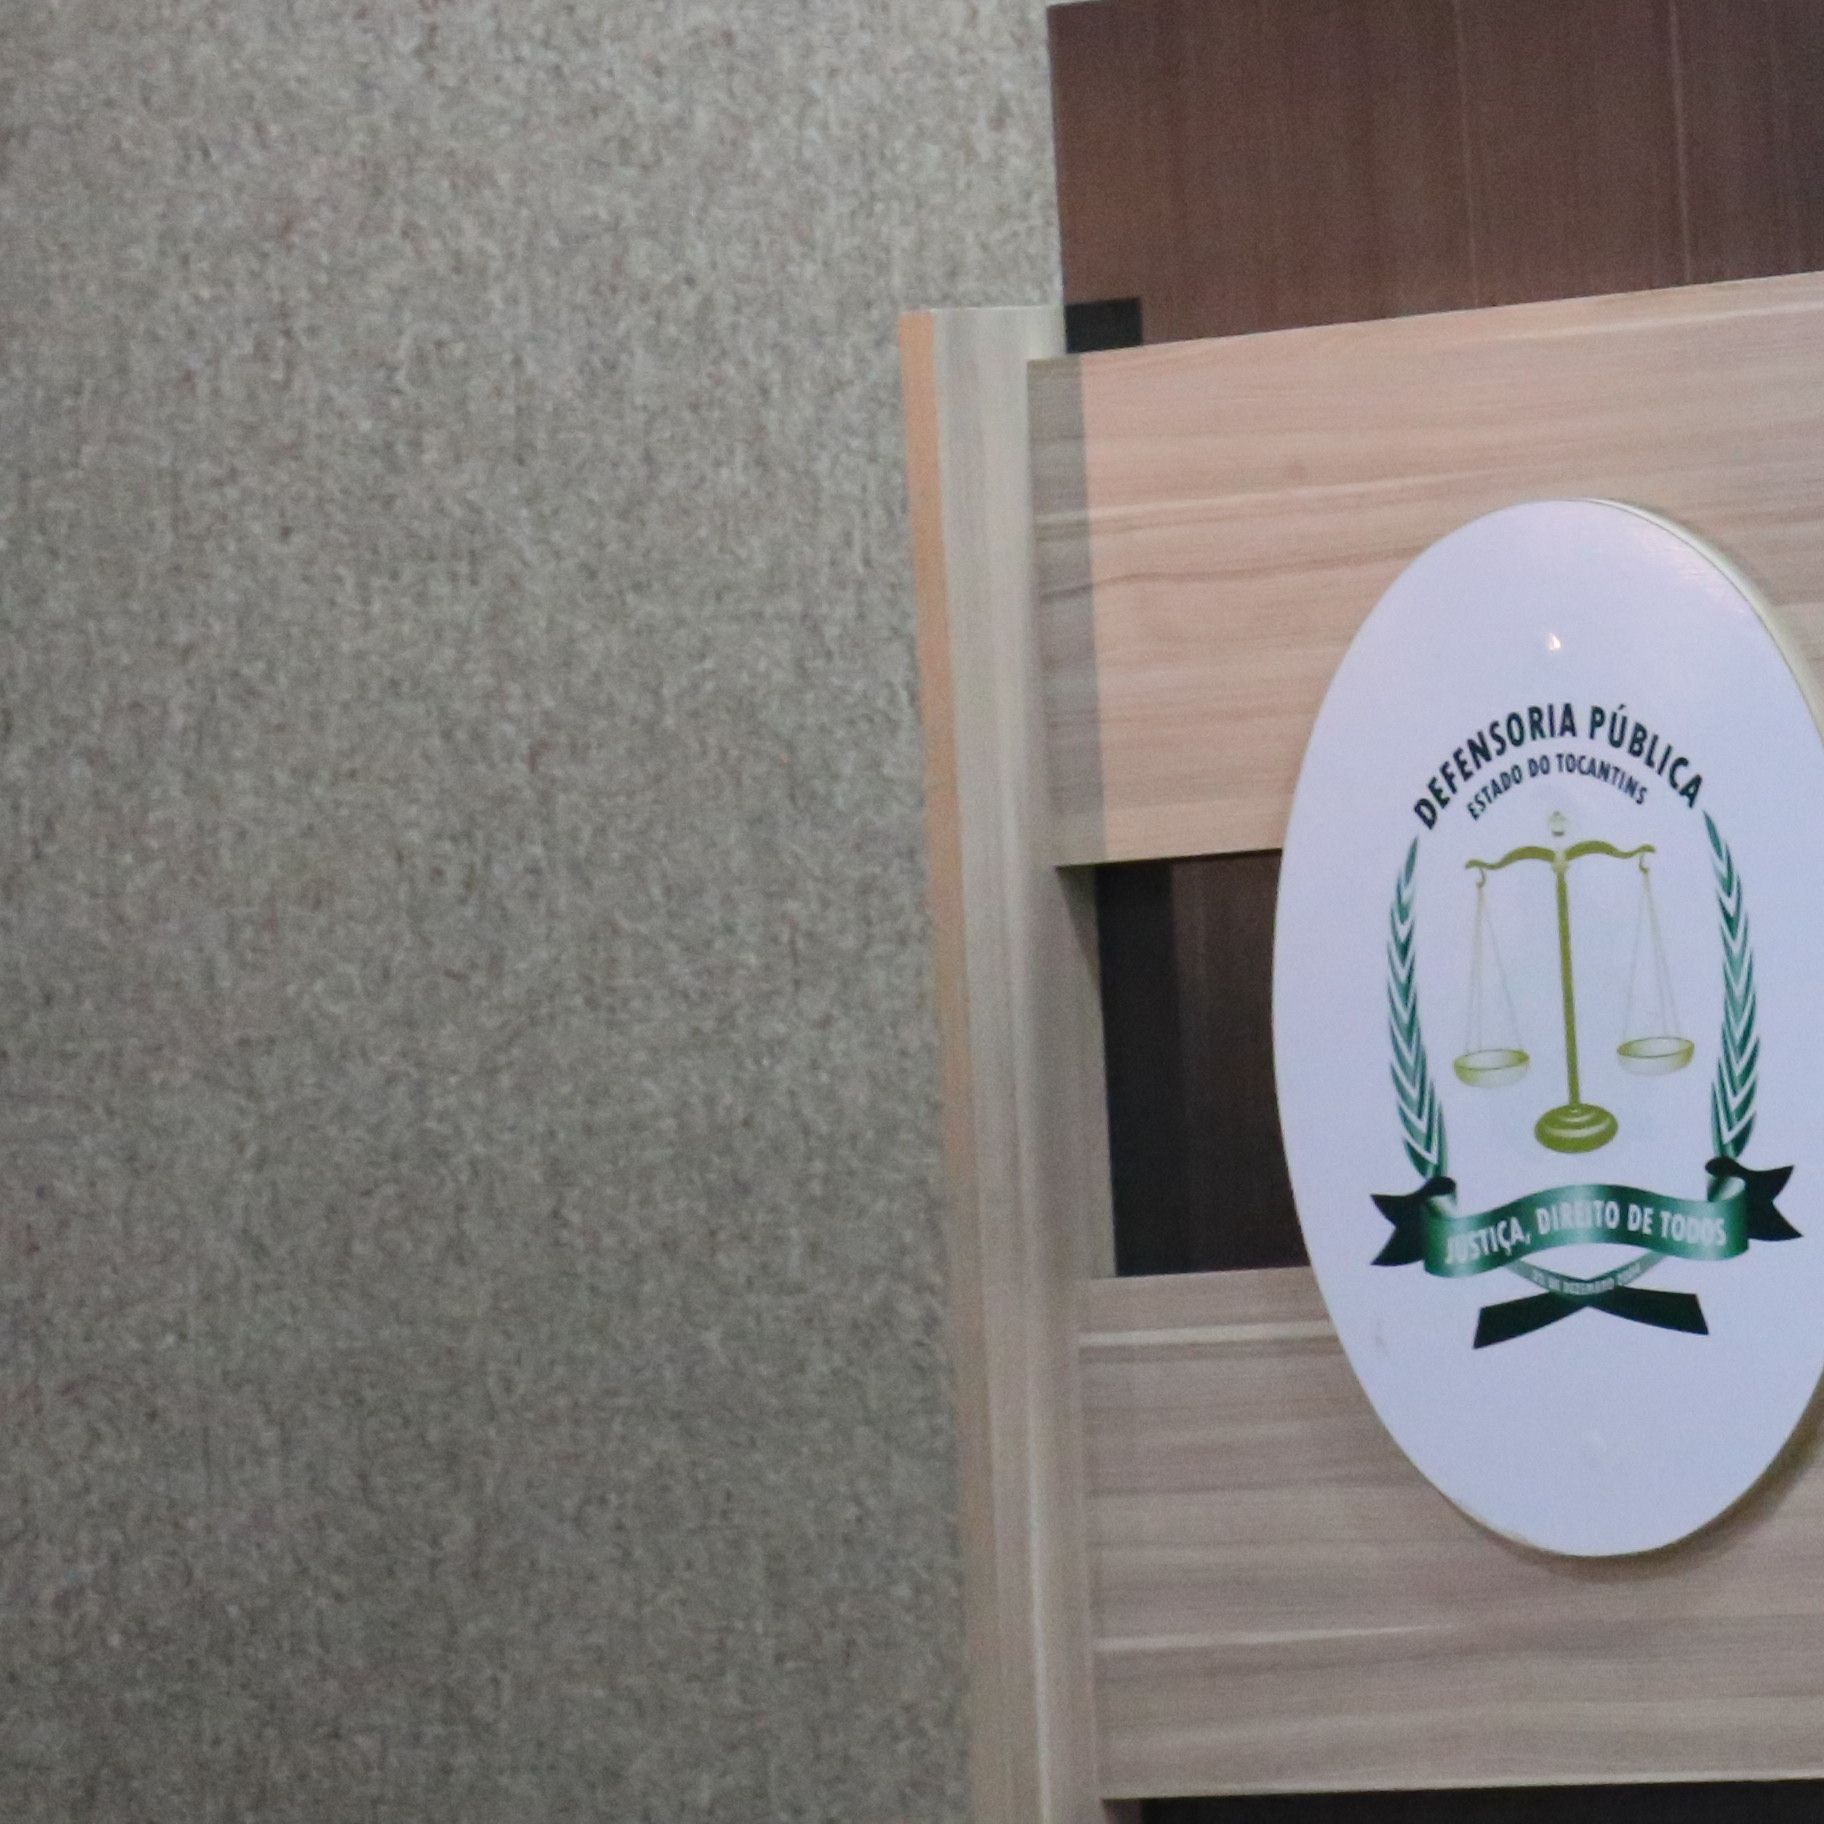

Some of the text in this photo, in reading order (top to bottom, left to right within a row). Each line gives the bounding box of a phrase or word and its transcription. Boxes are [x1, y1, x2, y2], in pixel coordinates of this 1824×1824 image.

[1413, 702, 1703, 830] DEFENSORIA PÚBLICA
[1465, 752, 1648, 821] ESTADO DO TOCANTINS
[1535, 1199, 1621, 1236] DIREITO
[1626, 1203, 1653, 1234] DE
[1659, 1210, 1728, 1247] TODOS
